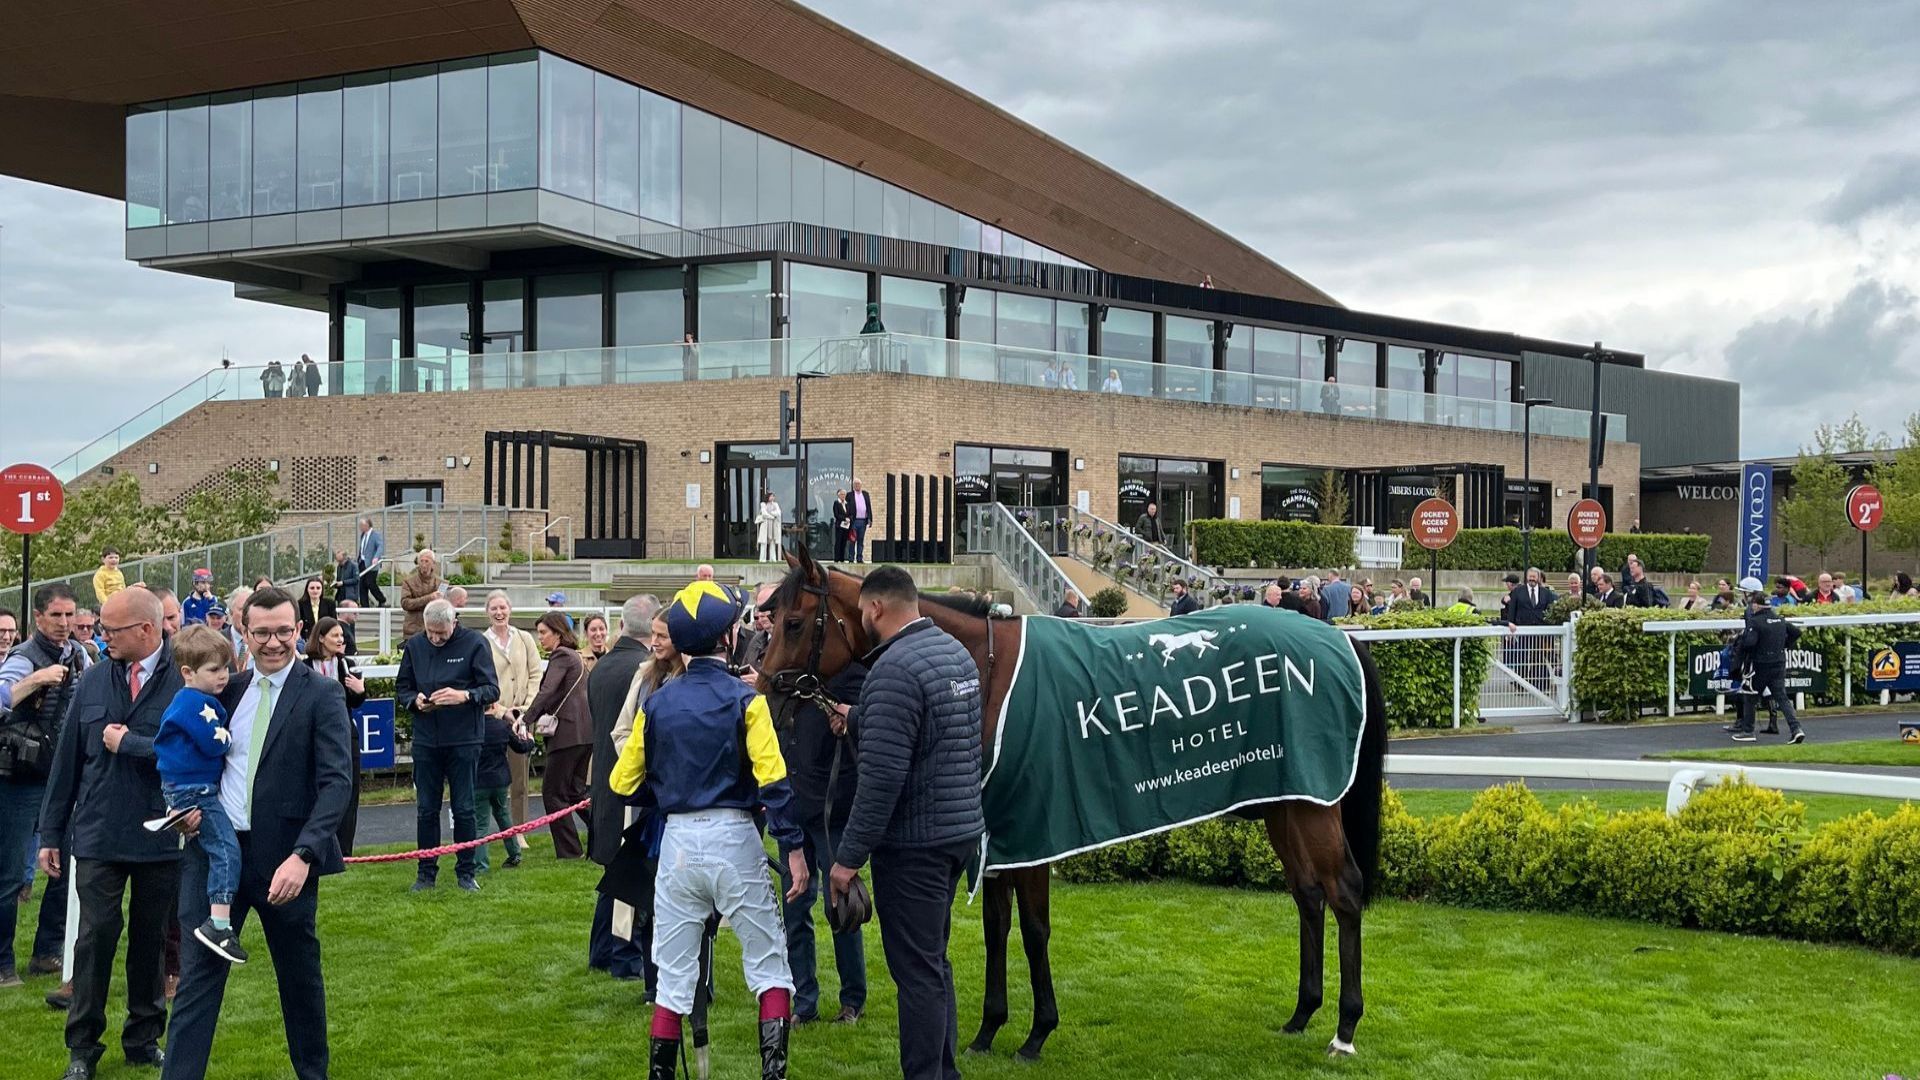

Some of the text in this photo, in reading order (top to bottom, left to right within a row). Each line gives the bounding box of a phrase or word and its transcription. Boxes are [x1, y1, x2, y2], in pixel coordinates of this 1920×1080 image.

[809, 473, 852, 486] CHAMPAGN
[1388, 485, 1412, 495] EMBERS
[1677, 485, 1741, 500] WELCO
[17, 490, 51, 523] 1st
[1282, 494, 1319, 509] CHAMPAGNE
[1426, 526, 1444, 534] ONLY
[1748, 472, 1767, 577] COOLMORE
[1077, 652, 1315, 739] KEADEEN
[1171, 720, 1248, 753] HOTEL
